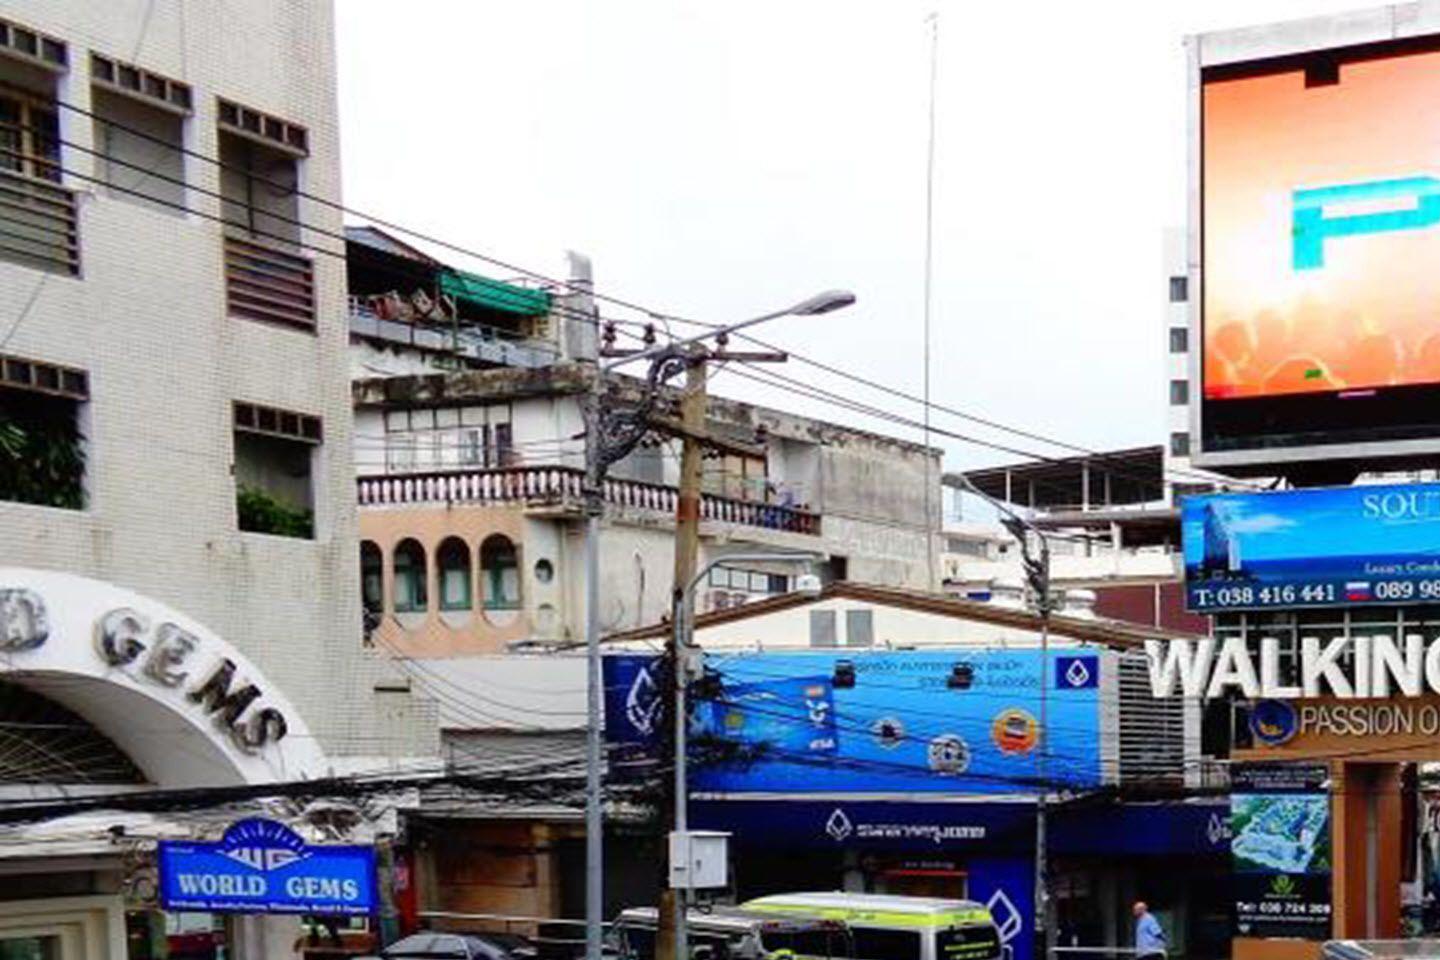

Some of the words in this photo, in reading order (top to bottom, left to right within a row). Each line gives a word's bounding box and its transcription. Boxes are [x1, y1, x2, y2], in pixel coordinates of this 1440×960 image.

[1258, 586, 1295, 603] 416
[1299, 584, 1335, 601] 441
[1375, 581, 1413, 599] 089
[94, 606, 288, 756] GEMS
[1301, 705, 1414, 736] PASSION
[178, 873, 266, 897] WORLD
[285, 876, 359, 901] GEMS
